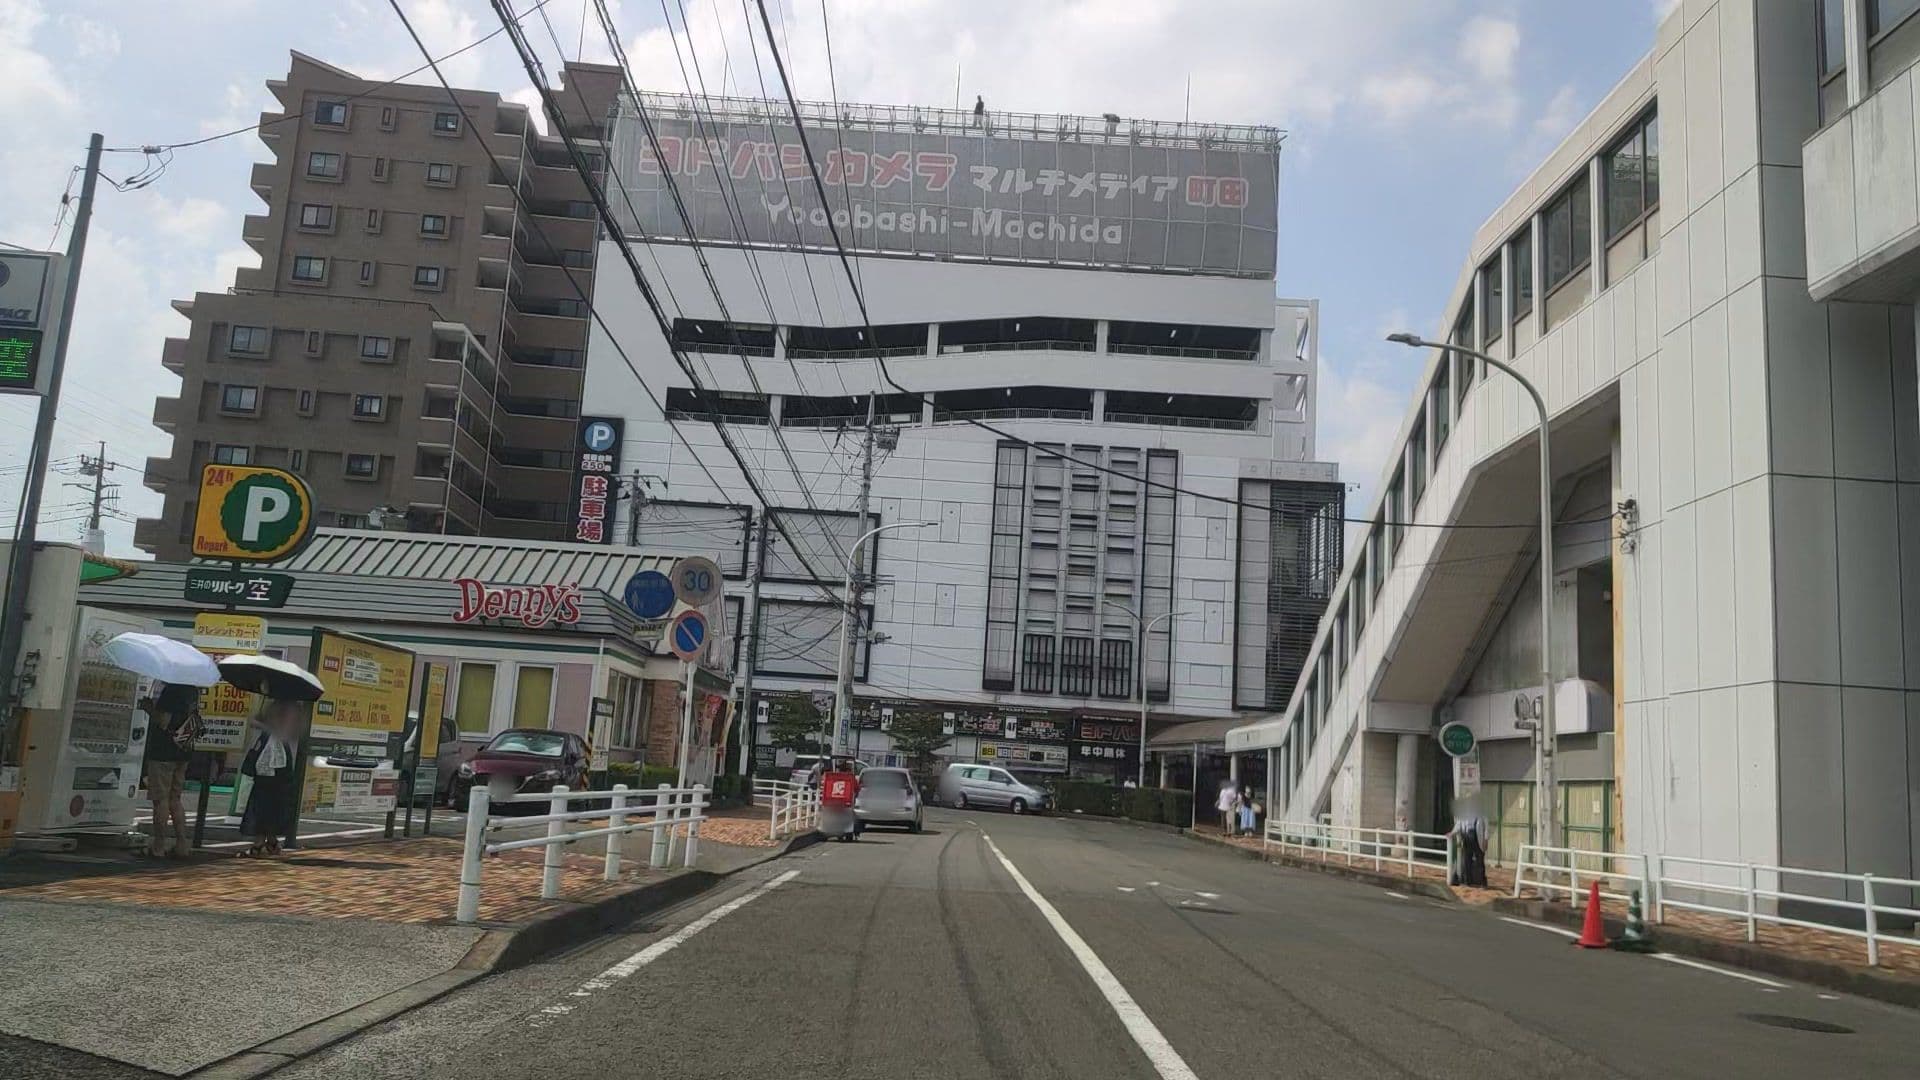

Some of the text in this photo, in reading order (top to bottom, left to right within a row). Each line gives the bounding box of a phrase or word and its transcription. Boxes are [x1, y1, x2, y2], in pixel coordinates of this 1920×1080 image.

[969, 165, 1179, 202] マルチメディア
[1186, 175, 1249, 208] 町田
[591, 425, 610, 448] P
[242, 485, 290, 542] P
[577, 475, 608, 543] 駐車場
[246, 577, 273, 601] 空
[684, 568, 711, 592] 30
[452, 577, 582, 628] Denny's
